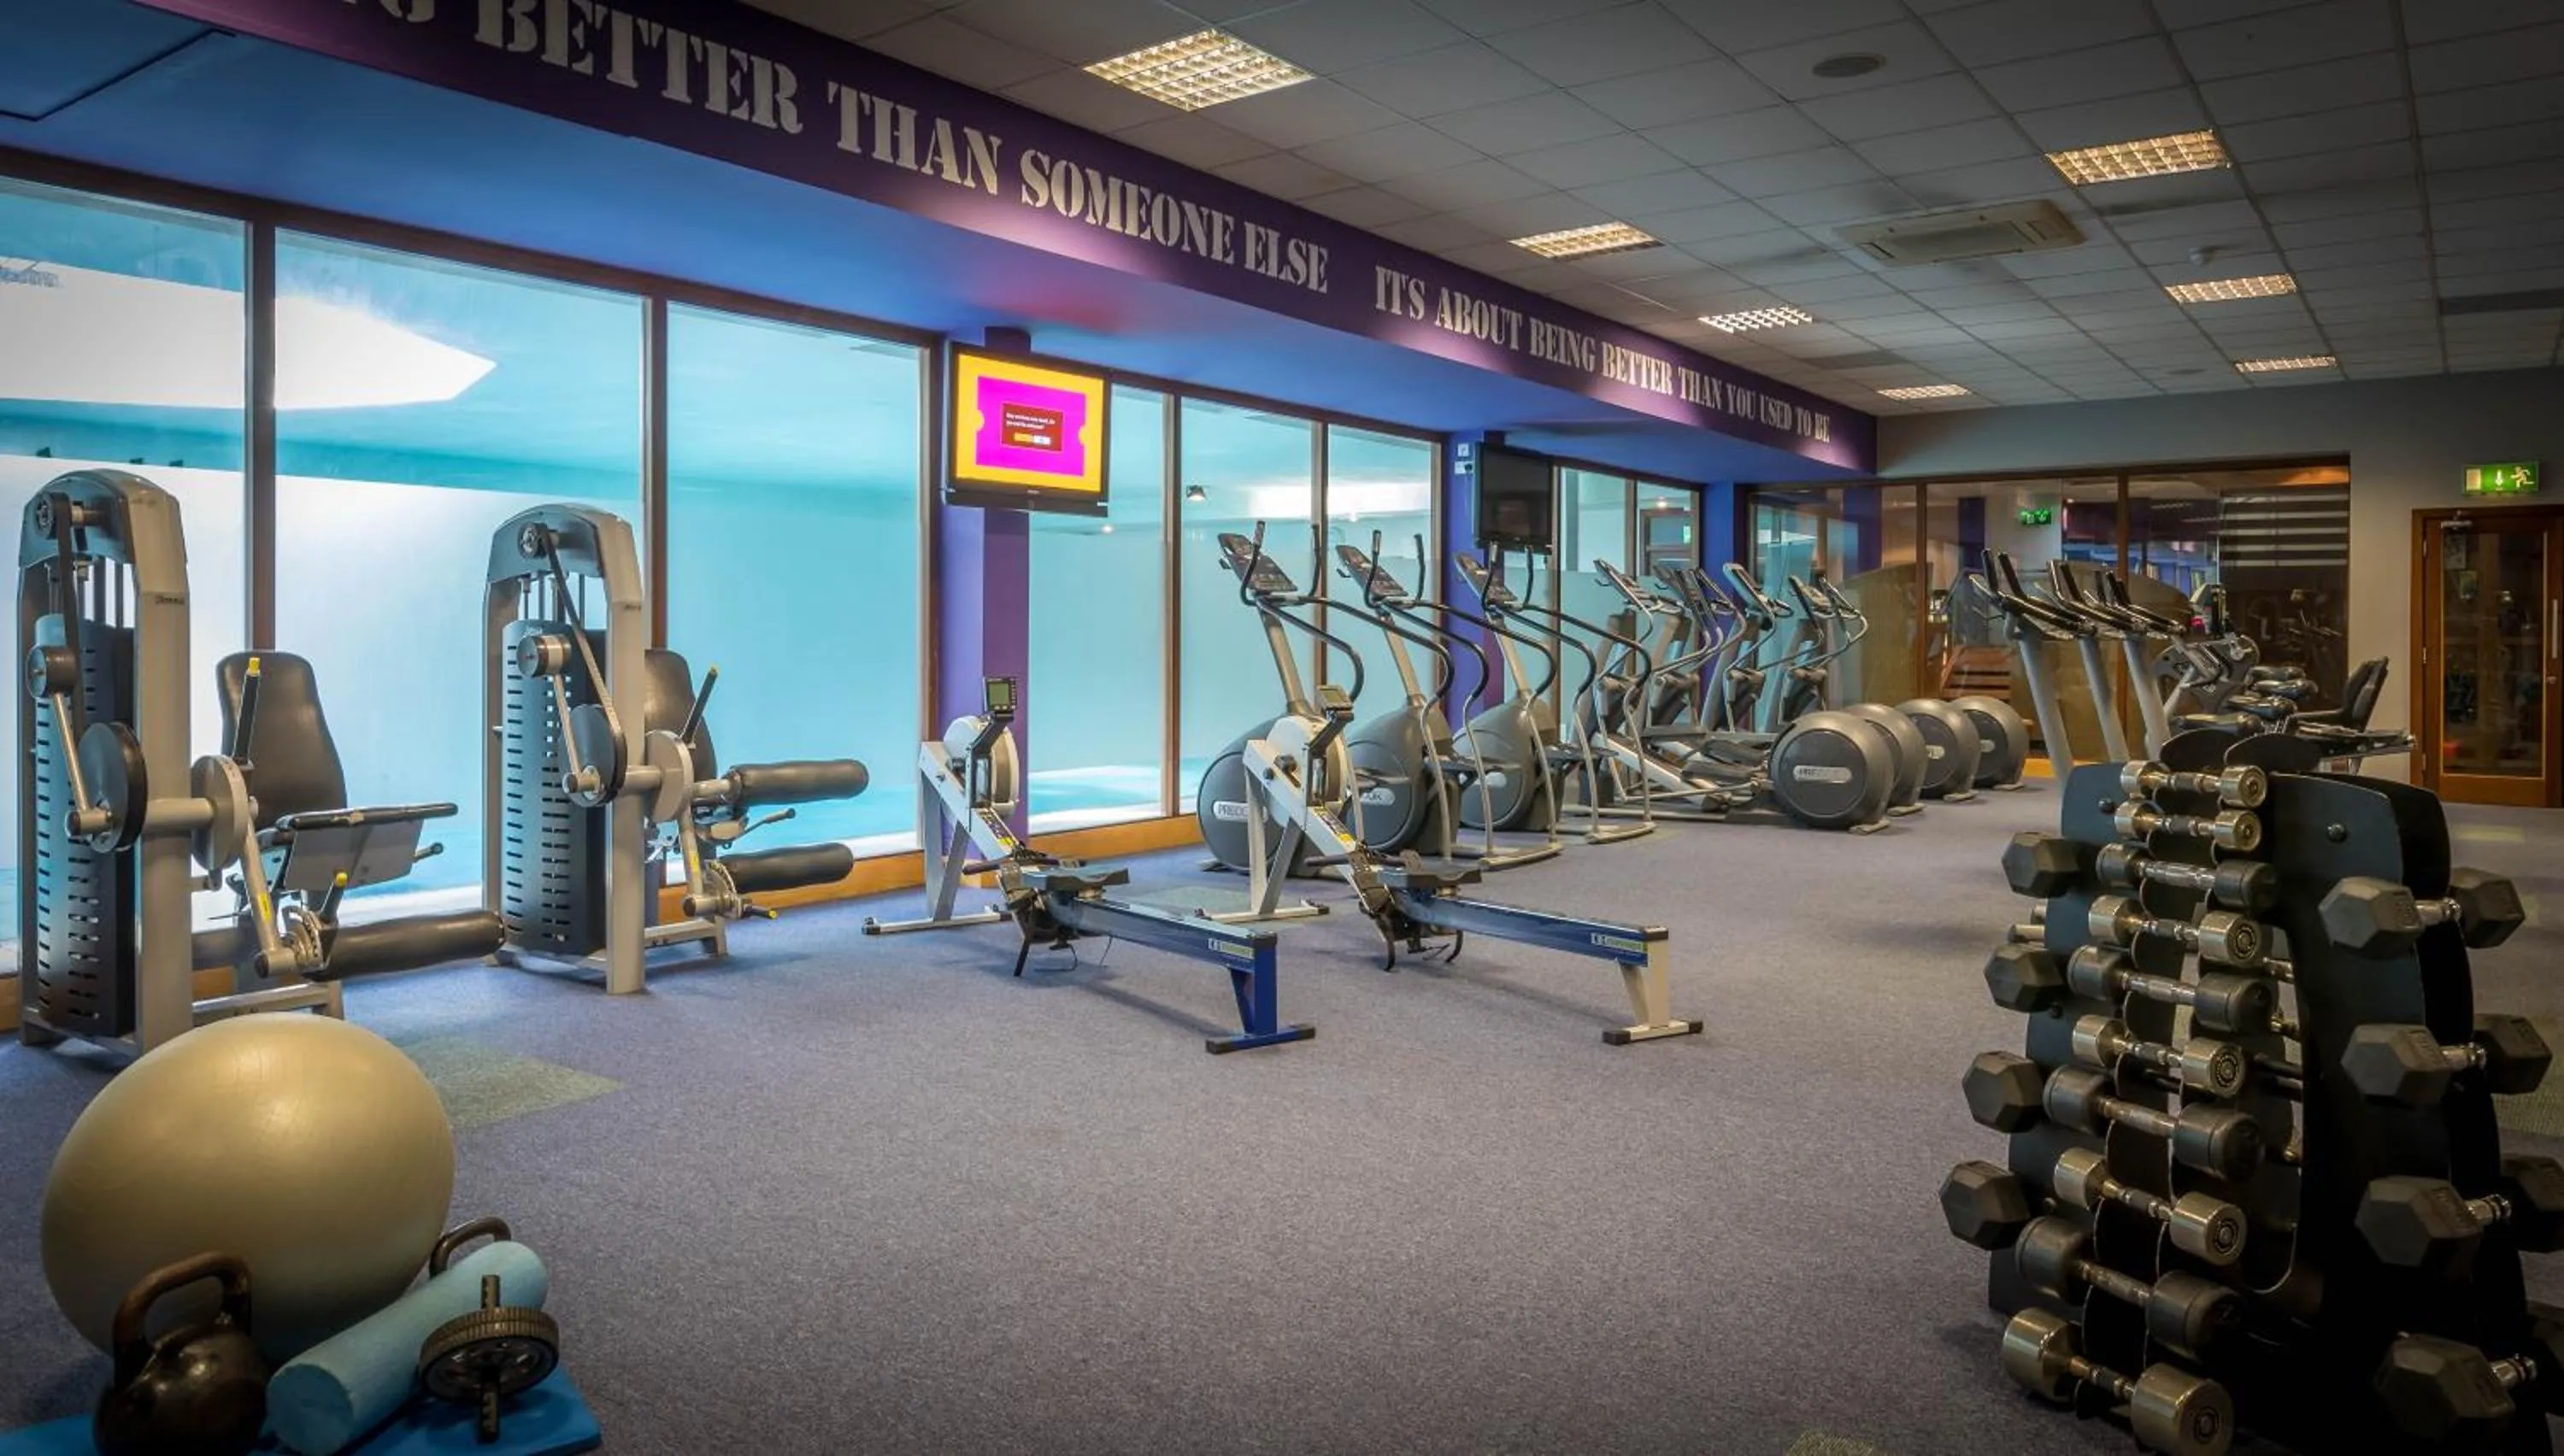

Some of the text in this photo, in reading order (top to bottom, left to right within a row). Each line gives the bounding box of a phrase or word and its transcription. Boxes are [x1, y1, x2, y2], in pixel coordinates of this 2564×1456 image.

[474, 0, 803, 133] BETTER
[828, 81, 1002, 195] THAN
[1020, 149, 1234, 265] SOMEONE
[1244, 220, 1328, 293] ELSE
[1434, 287, 1522, 350] ABOUT
[1529, 317, 1597, 372] BEING
[1602, 342, 1673, 396] BETTER
[1678, 366, 1721, 409] THAN
[1726, 384, 1755, 420] YOU
[1760, 395, 1792, 429] USED
[1797, 406, 1811, 437] TO
[1814, 414, 1831, 443] BE
